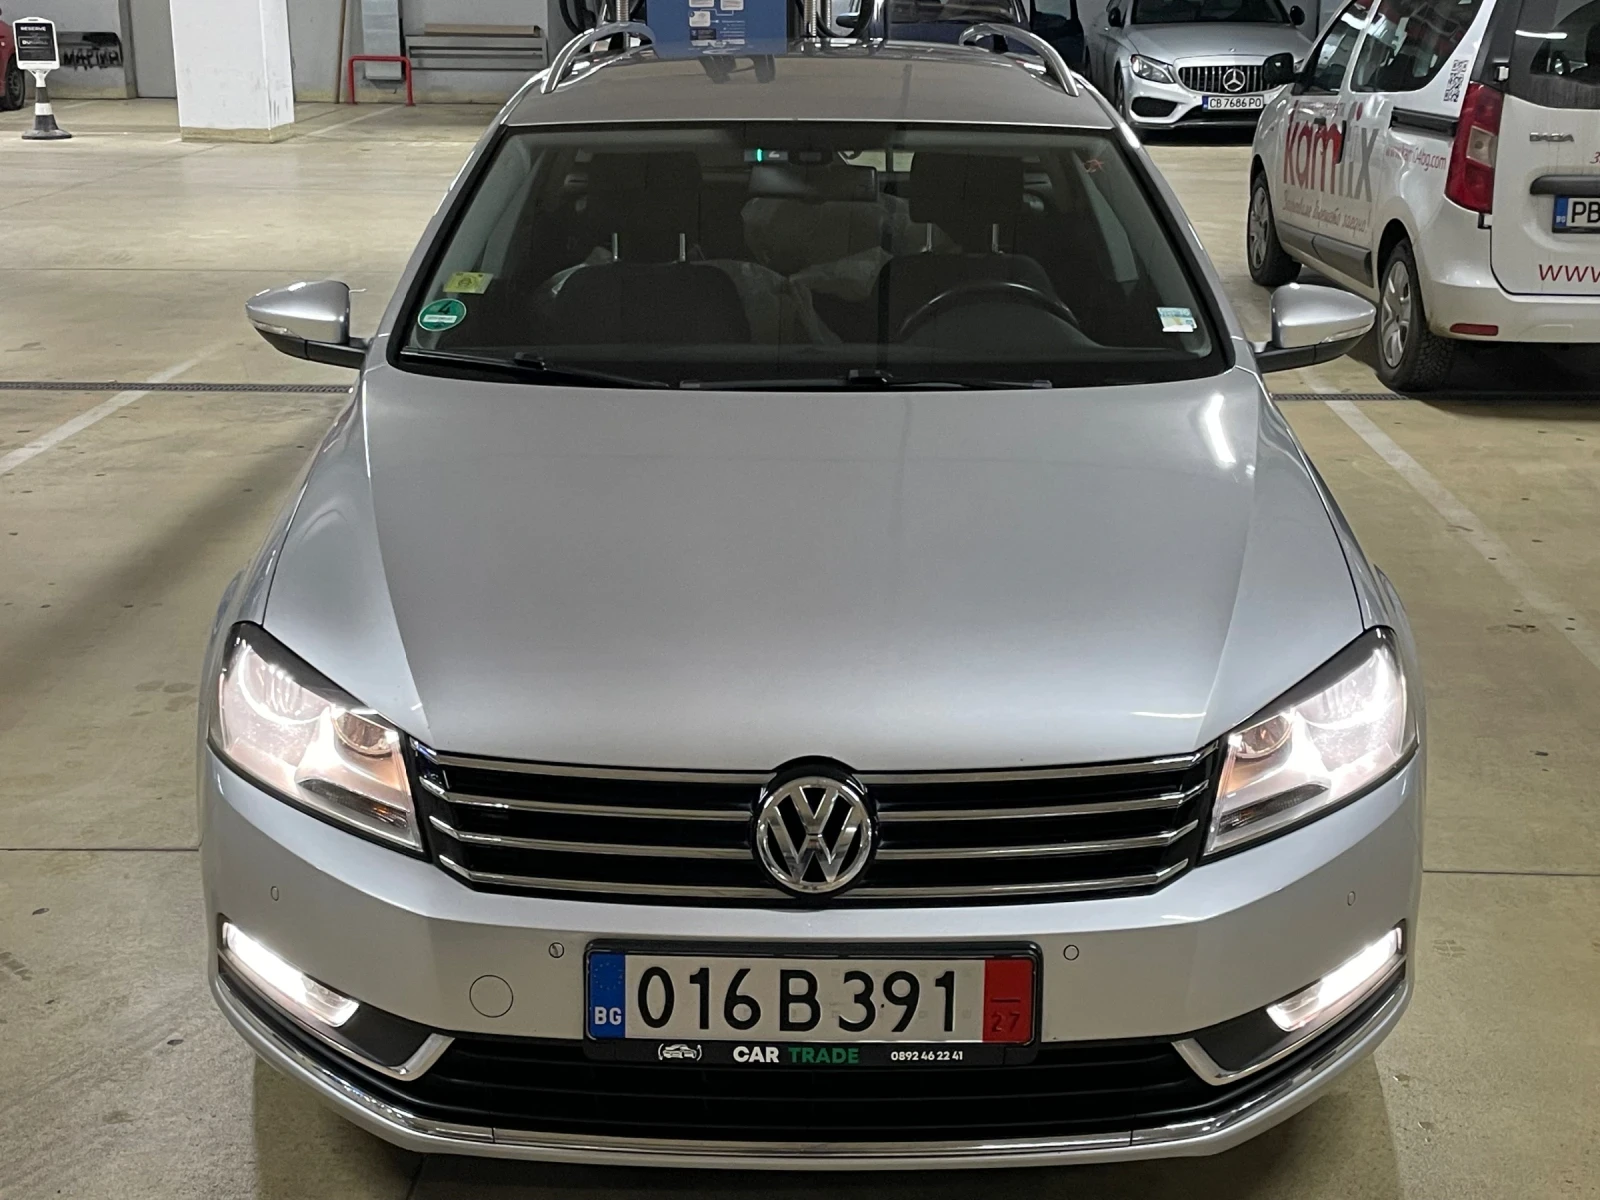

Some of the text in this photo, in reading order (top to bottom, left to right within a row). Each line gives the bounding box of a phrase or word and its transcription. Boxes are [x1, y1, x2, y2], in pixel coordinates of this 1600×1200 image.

[1210, 98, 1222, 108] CB
[1223, 98, 1247, 108] 7686
[594, 1006, 622, 1026] BG
[991, 1010, 1020, 1032] 27
[732, 1046, 859, 1064] CAR TRADE
[890, 1051, 919, 1061] 0892
